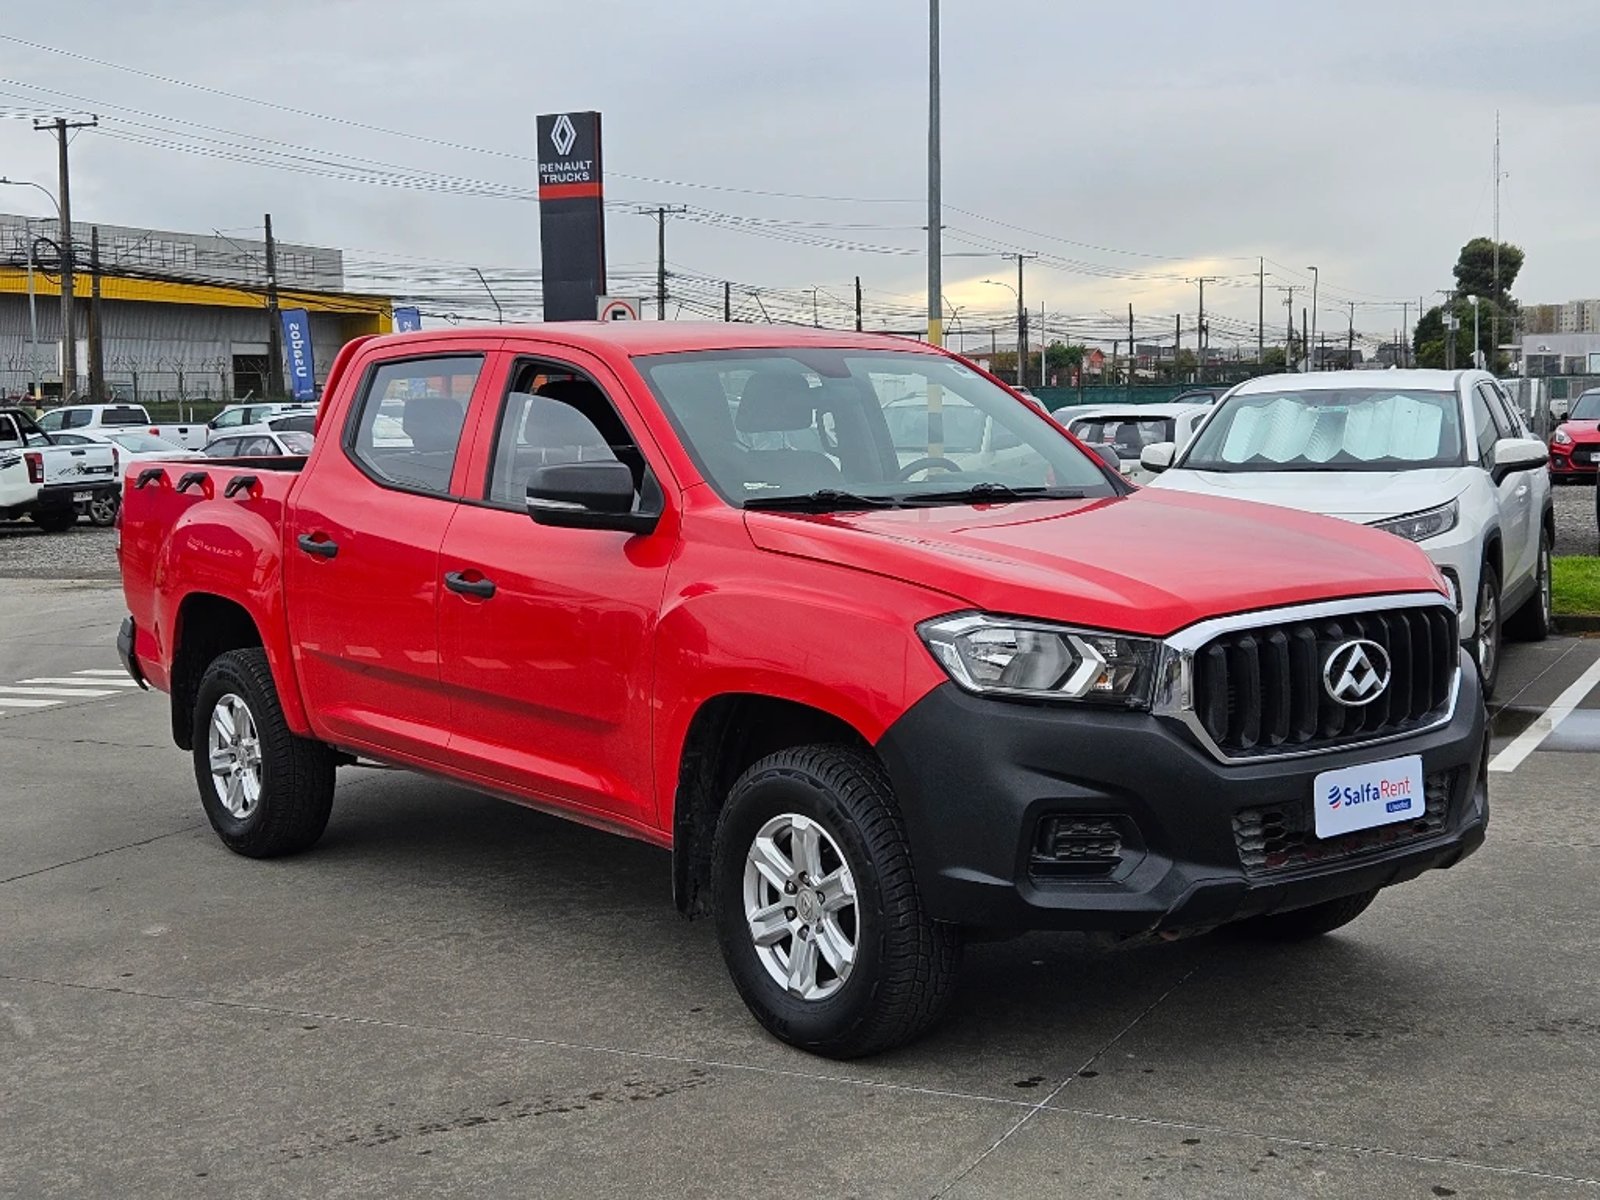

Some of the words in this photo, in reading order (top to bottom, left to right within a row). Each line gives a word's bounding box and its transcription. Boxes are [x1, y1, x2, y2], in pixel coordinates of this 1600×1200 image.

[539, 160, 593, 173] RENAULT
[542, 171, 590, 184] TRUCKS
[1344, 776, 1411, 806] SalfaRent
